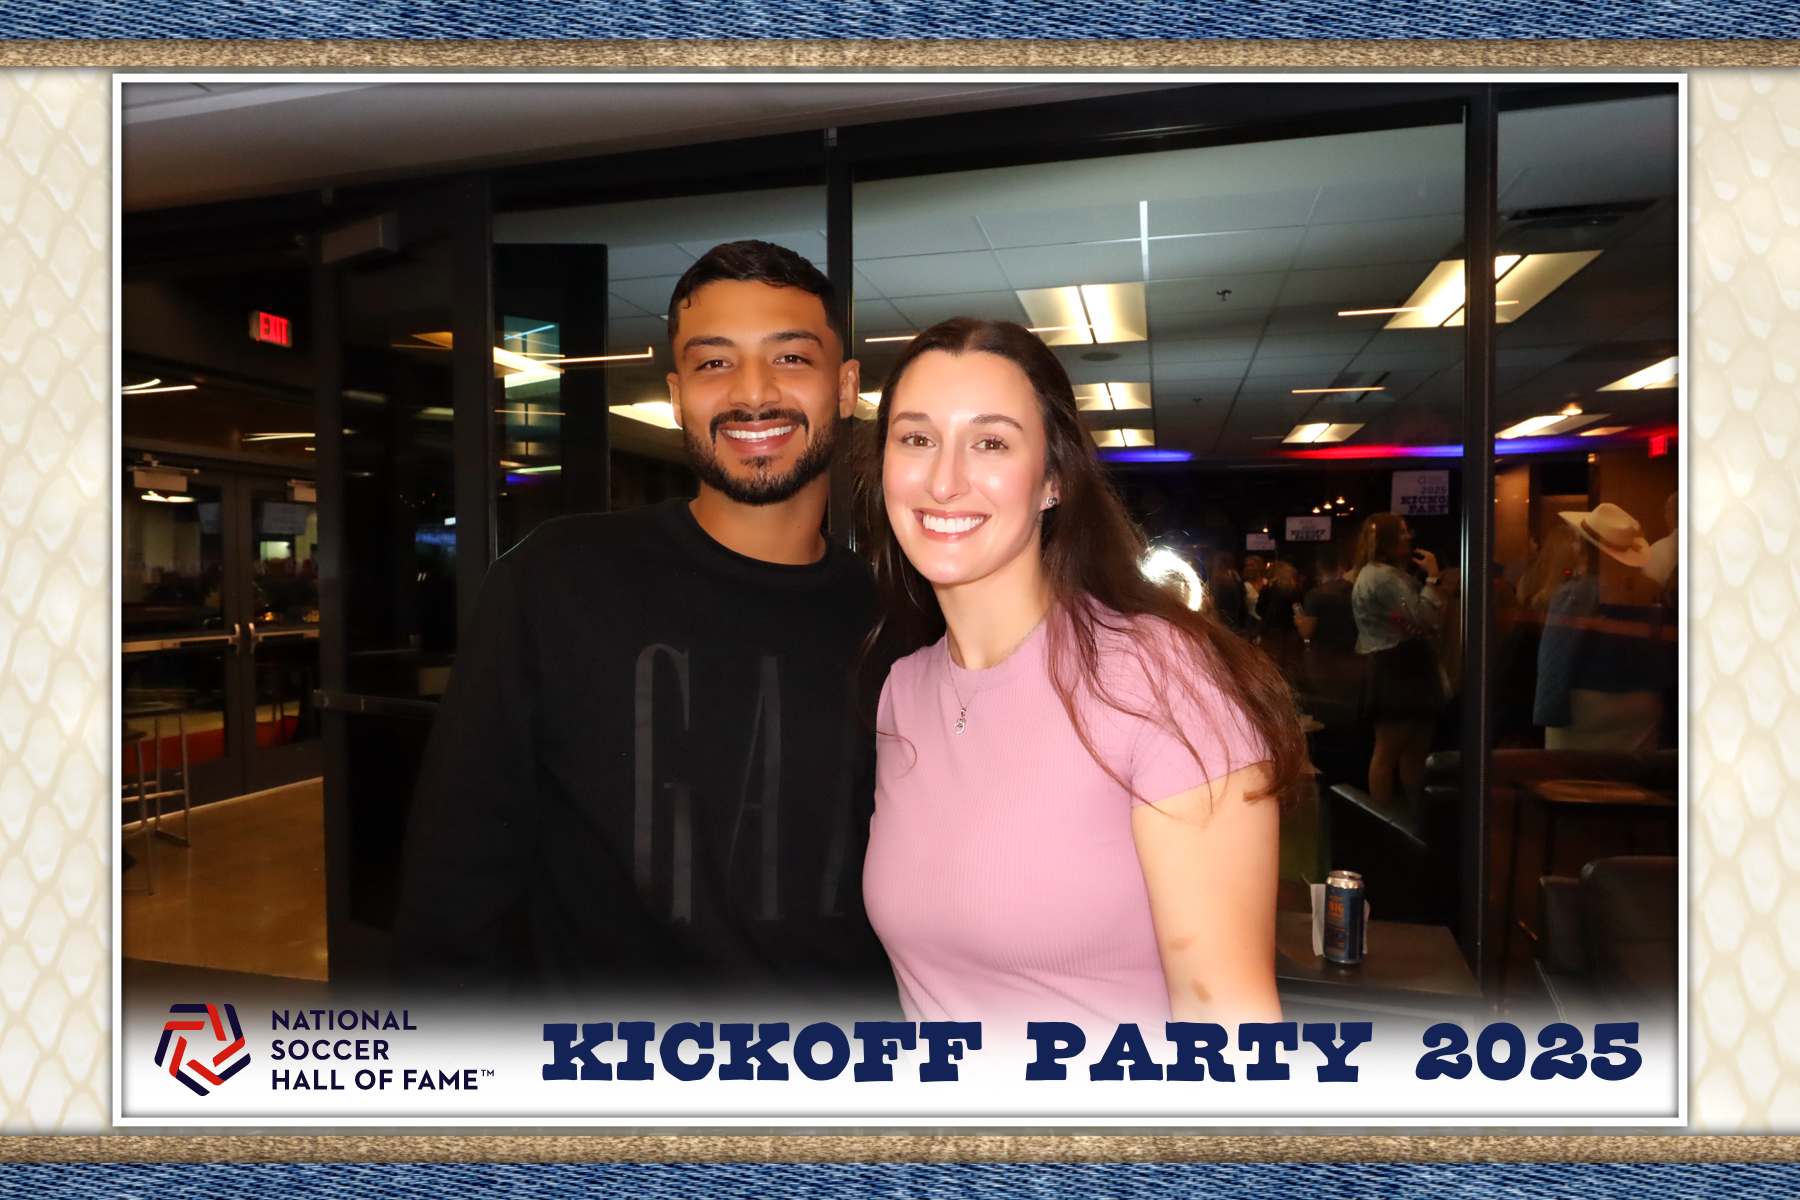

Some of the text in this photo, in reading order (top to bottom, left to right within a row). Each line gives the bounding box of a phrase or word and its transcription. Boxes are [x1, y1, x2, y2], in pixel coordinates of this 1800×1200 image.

[260, 311, 288, 345] EXIT
[1421, 486, 1447, 495] 2025
[1400, 495, 1449, 505] KICKO
[634, 643, 858, 923] GA
[1329, 901, 1345, 914] BIG
